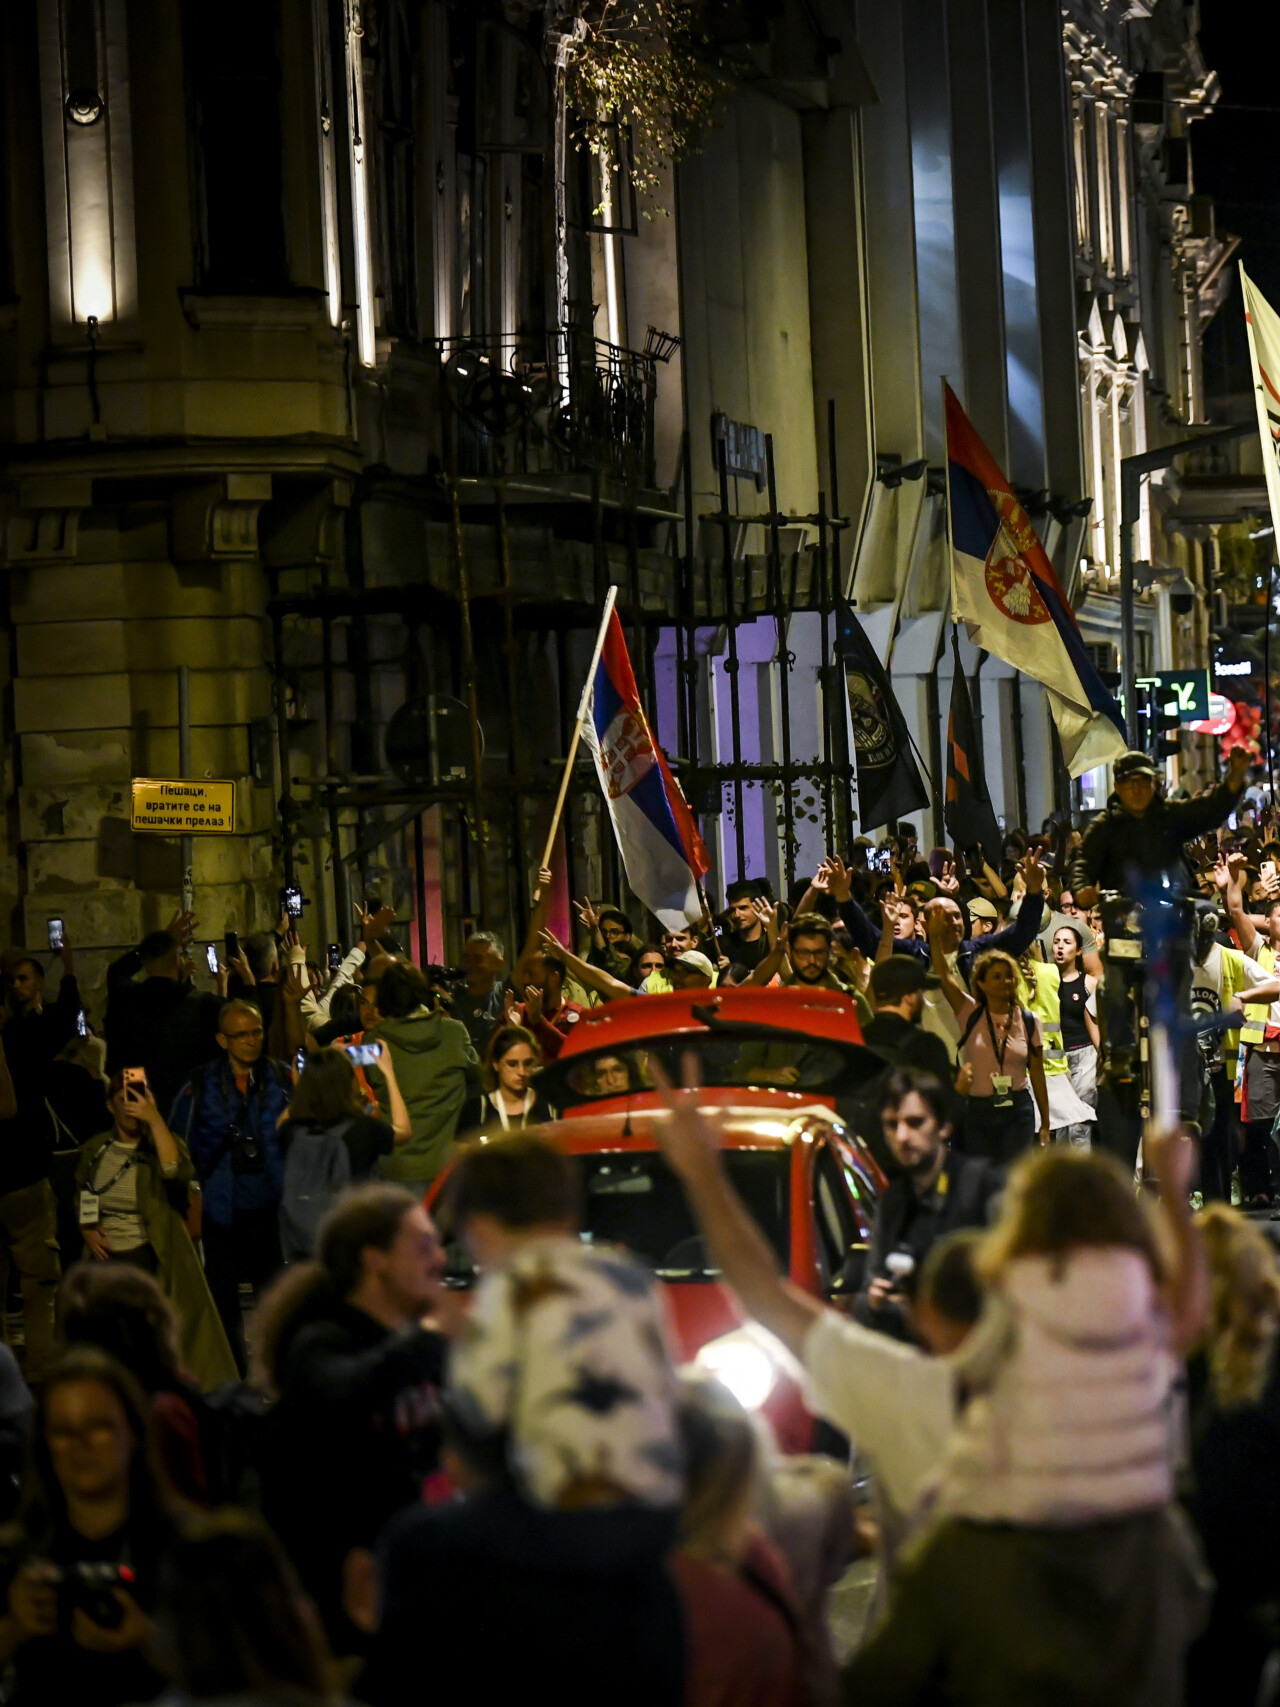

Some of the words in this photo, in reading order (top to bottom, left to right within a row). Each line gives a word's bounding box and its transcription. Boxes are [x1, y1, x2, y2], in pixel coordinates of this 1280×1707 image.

[160, 785, 207, 798] Пешаци,
[146, 802, 190, 812] вратите
[193, 803, 205, 811] се
[209, 803, 221, 812] на
[135, 815, 182, 825] пешачки
[186, 817, 224, 827] прелаз
